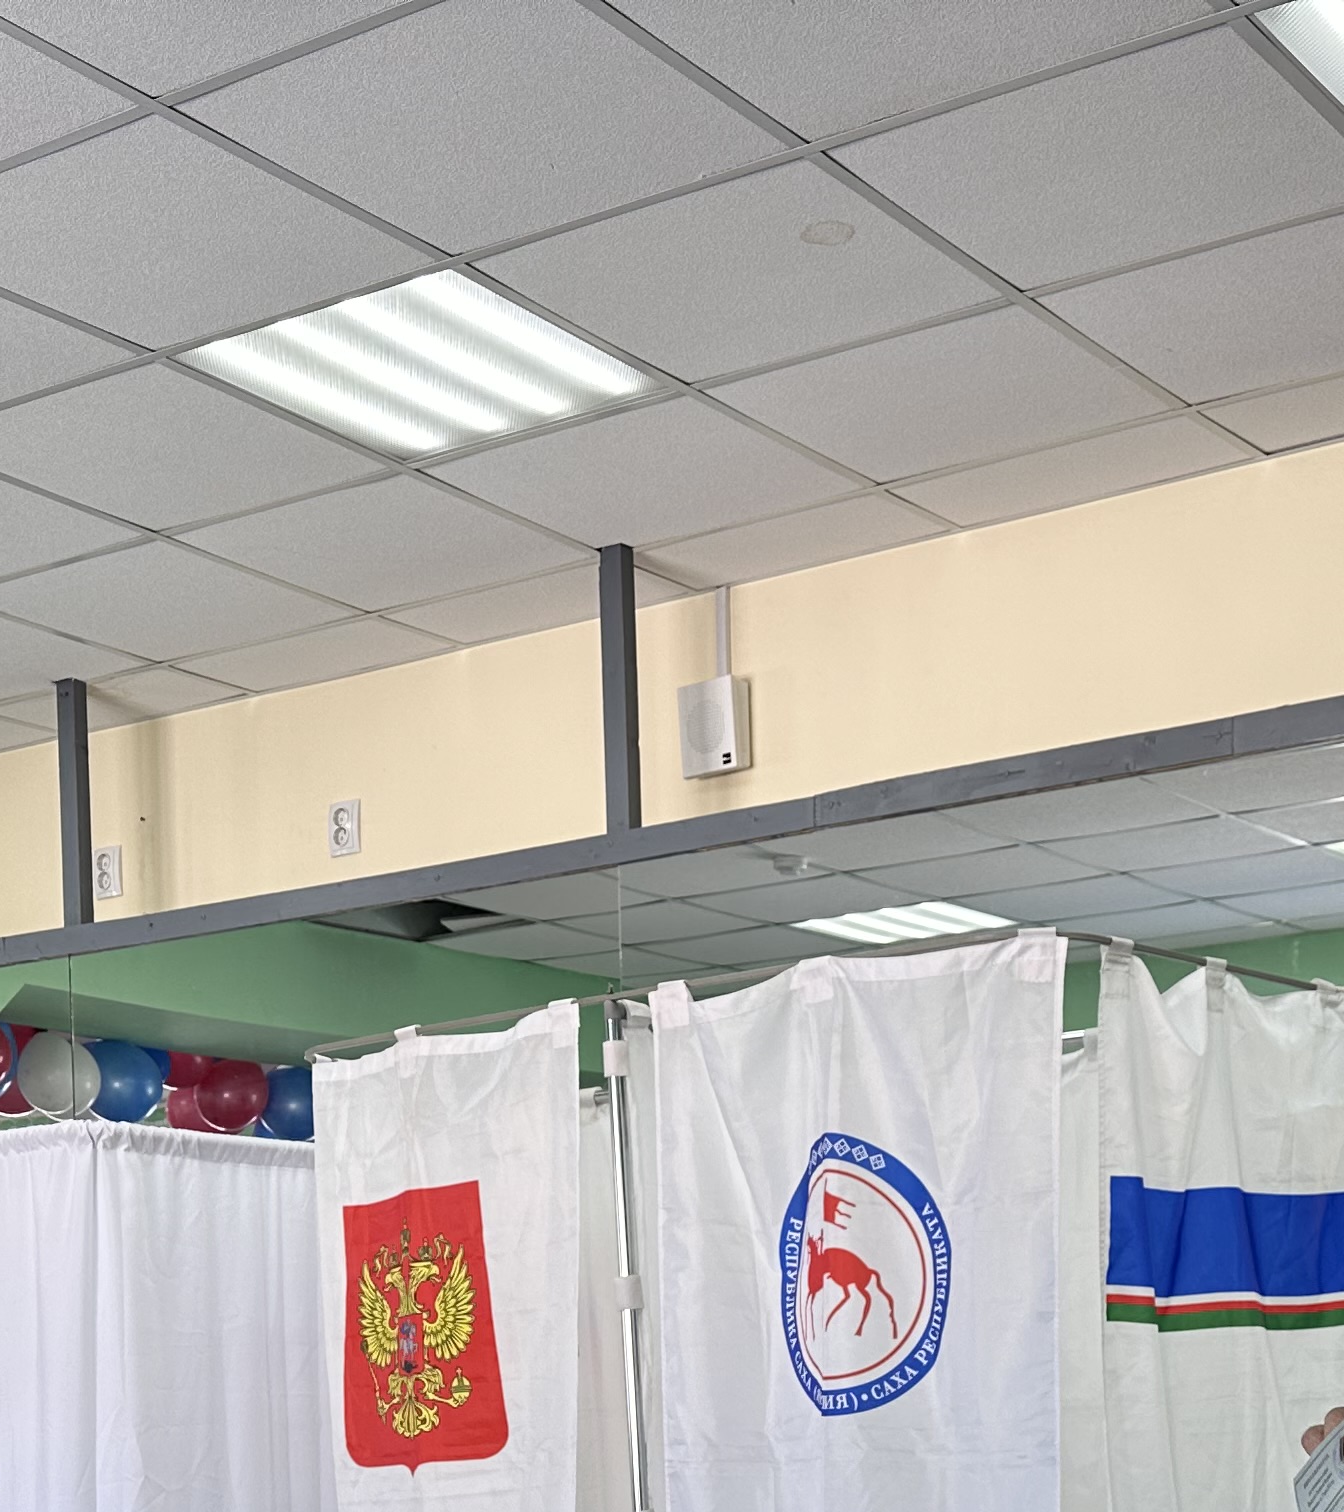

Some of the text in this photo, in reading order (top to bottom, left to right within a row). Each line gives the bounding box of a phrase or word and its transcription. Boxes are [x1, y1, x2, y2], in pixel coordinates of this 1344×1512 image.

[785, 1217, 803, 1350] РЕСПУБЛИКА
[871, 1202, 947, 1399] САХА РЕСПУБЛИКАТА
